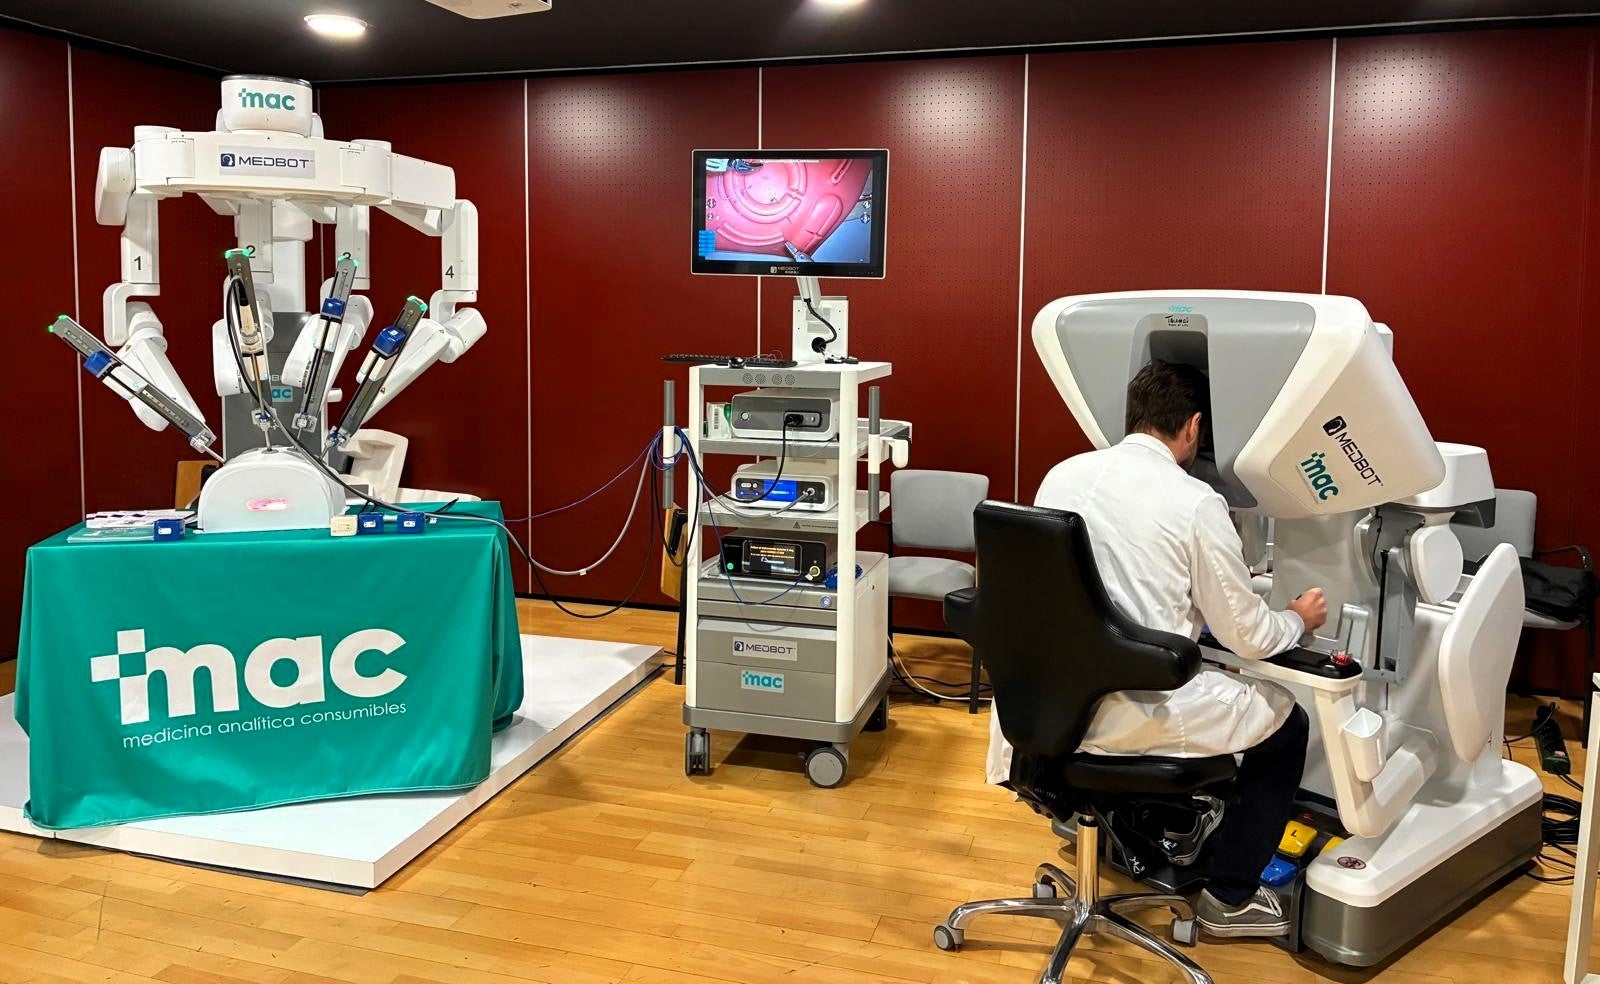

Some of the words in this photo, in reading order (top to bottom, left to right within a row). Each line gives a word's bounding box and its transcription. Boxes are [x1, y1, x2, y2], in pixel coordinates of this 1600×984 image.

[238, 88, 296, 111] mac
[239, 156, 310, 168] MEDBOT
[133, 255, 142, 271] 1
[445, 264, 455, 279] 4
[1334, 431, 1382, 486] MEDBOT
[1300, 452, 1339, 501] mac
[745, 643, 793, 654] MEDBOT
[90, 628, 408, 725] mac
[742, 671, 783, 689] mac
[123, 723, 212, 748] medicina
[218, 714, 295, 735] analítica
[300, 701, 407, 725] consumibles
